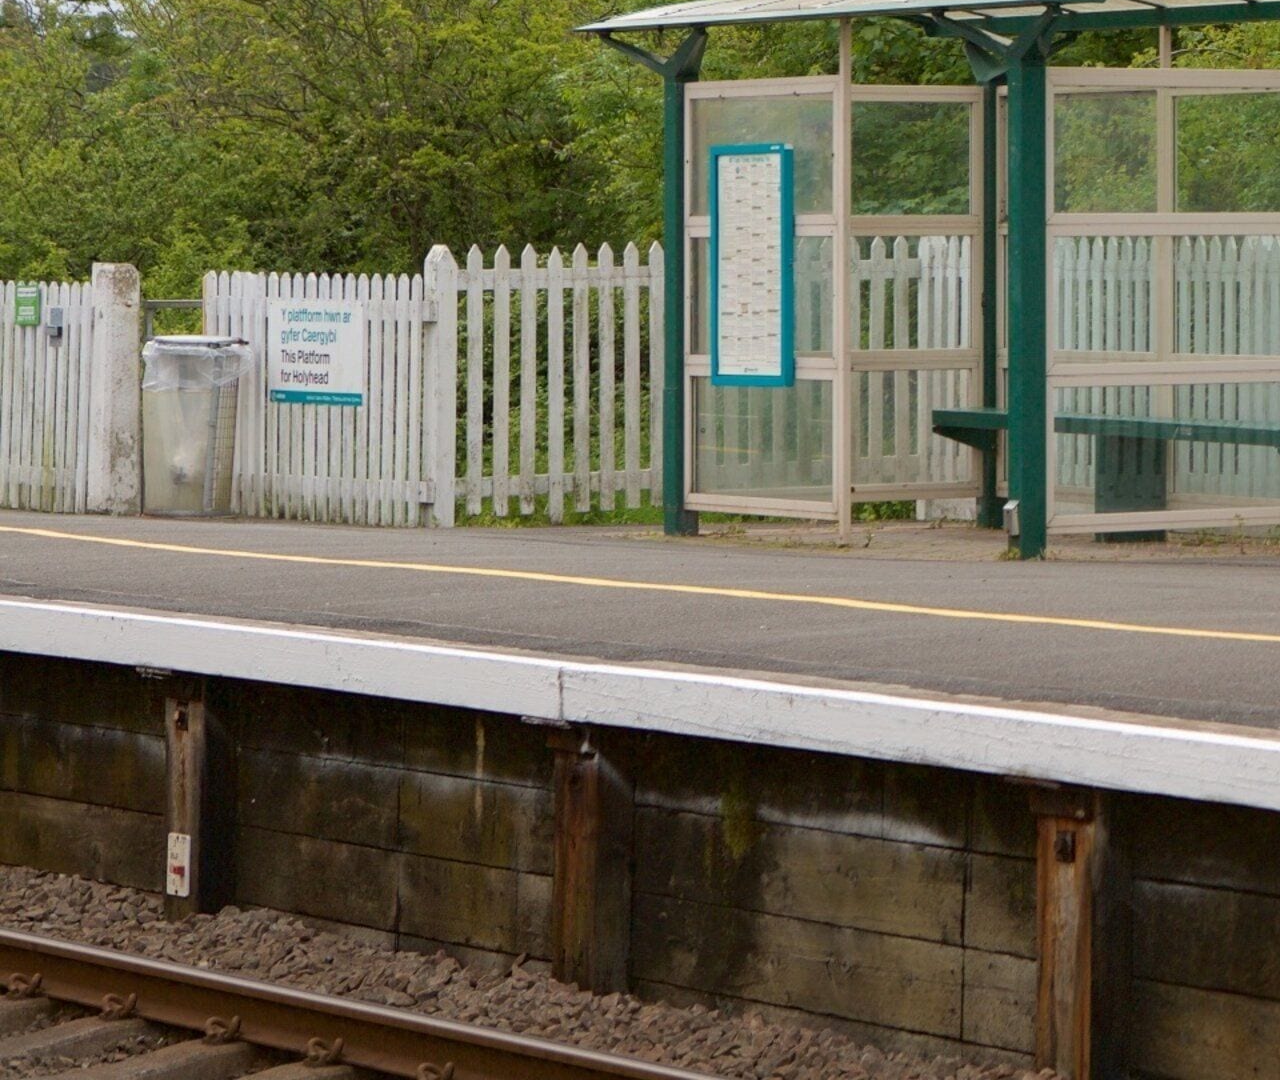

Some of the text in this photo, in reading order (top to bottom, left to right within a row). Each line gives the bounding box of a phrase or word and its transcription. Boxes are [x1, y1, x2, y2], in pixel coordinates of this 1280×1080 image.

[281, 308, 287, 321] Y
[324, 309, 341, 323] hwn
[343, 311, 352, 324] ar
[281, 328, 337, 345] gyfer Caergybi
[281, 349, 331, 365] This Platform
[281, 369, 329, 387] for Holyhead
